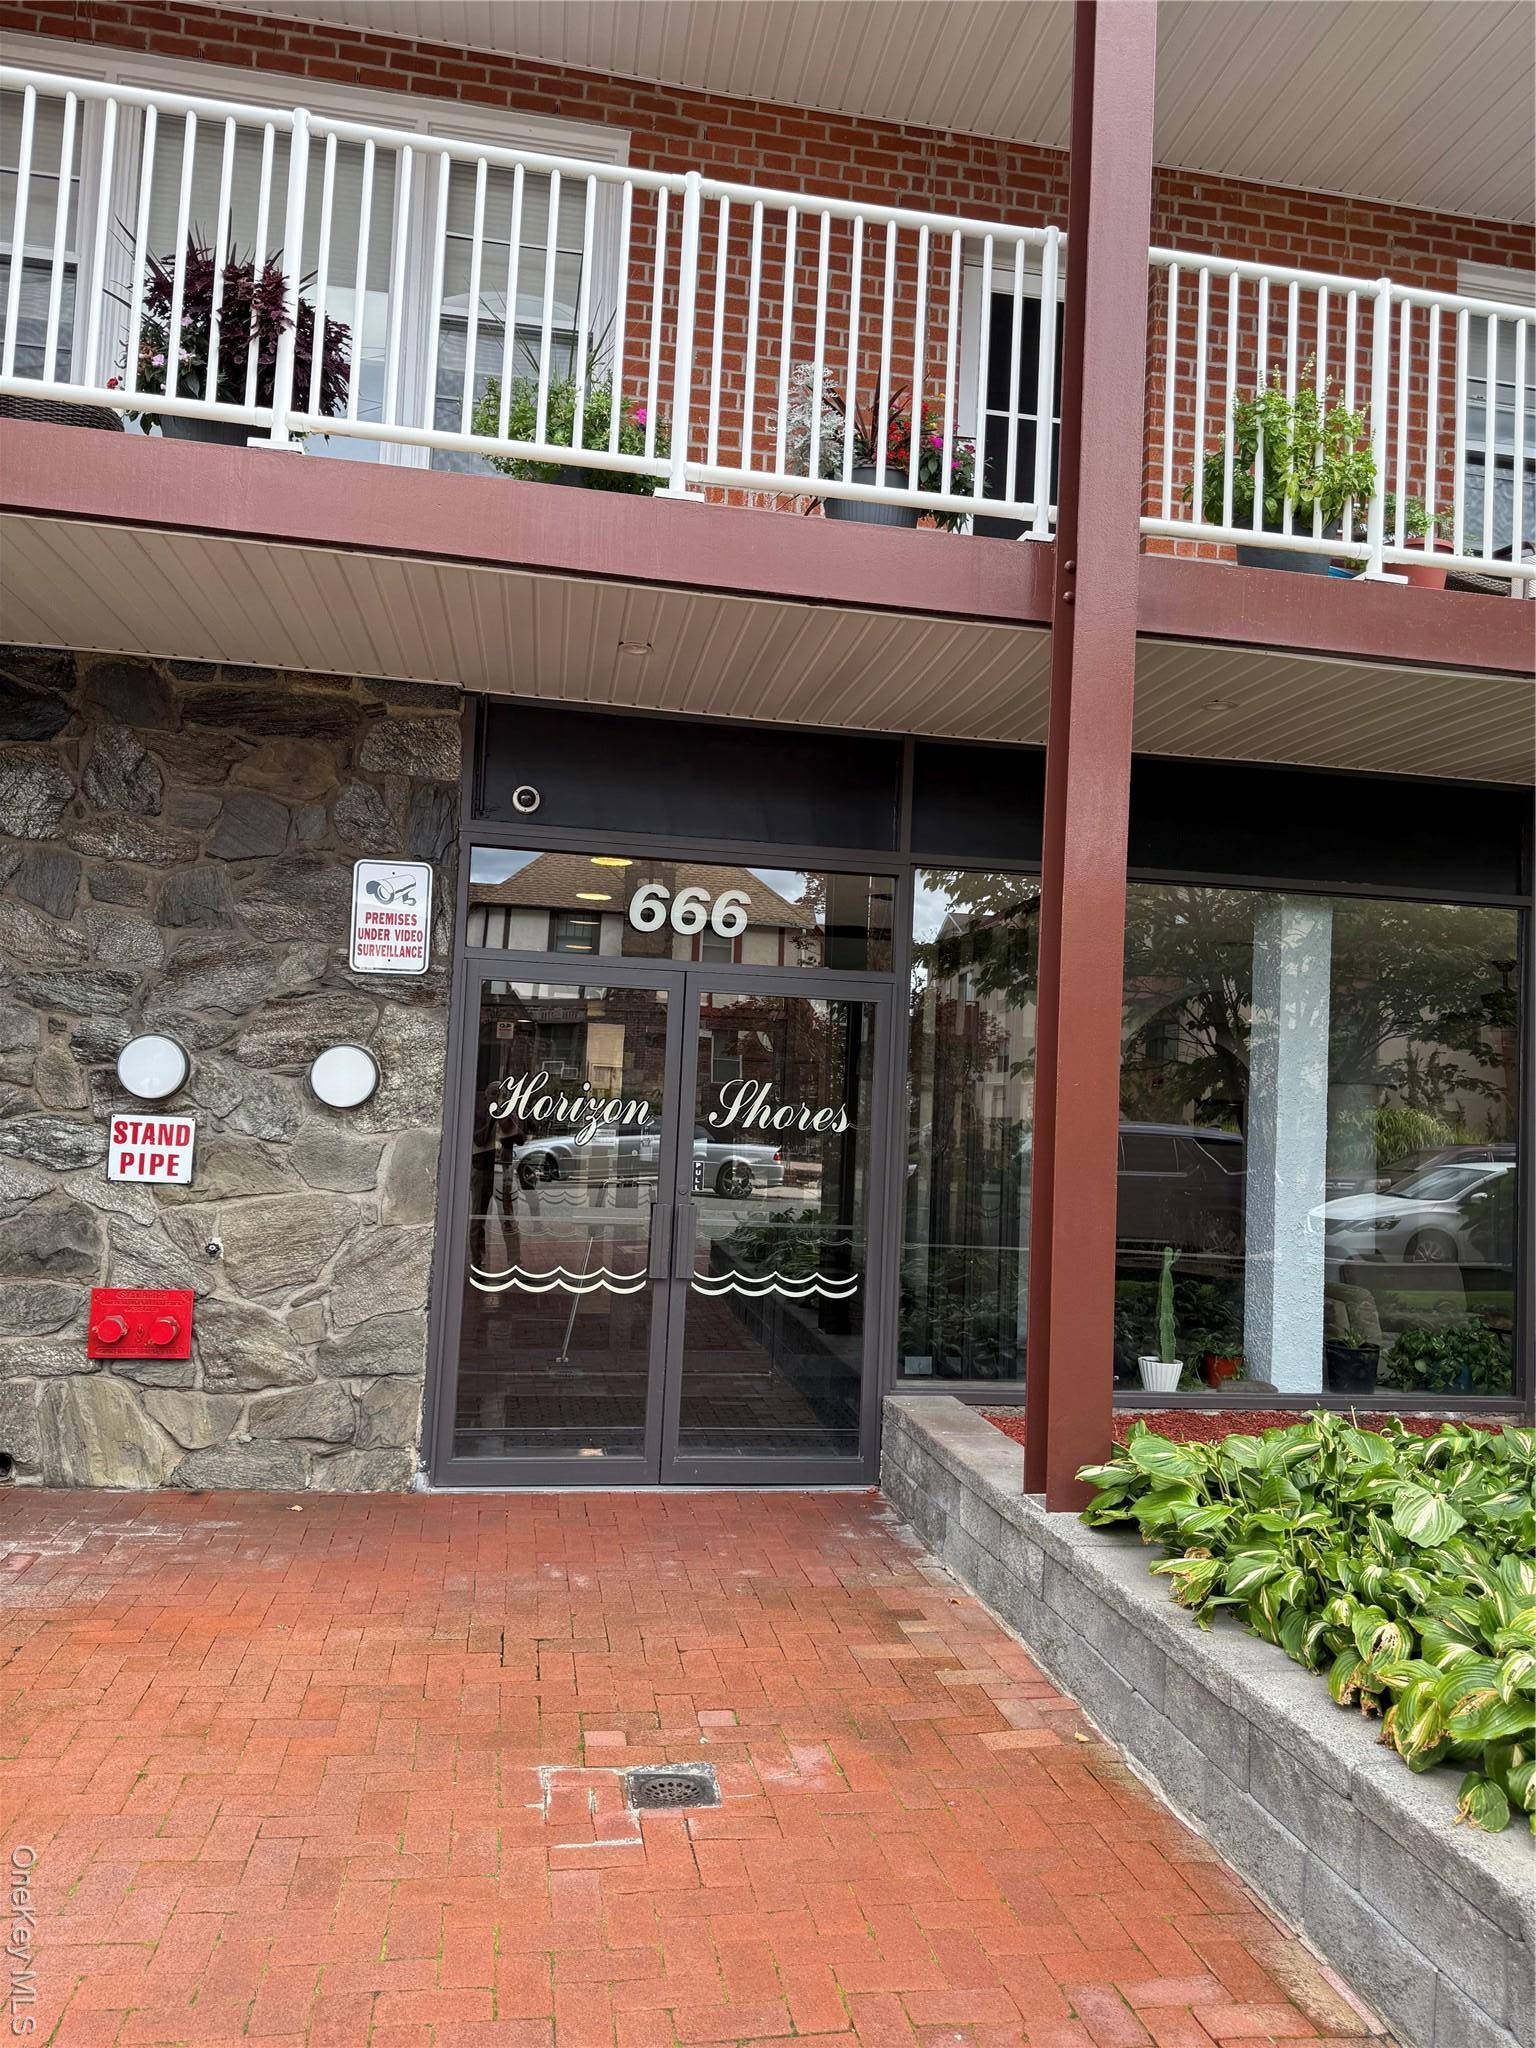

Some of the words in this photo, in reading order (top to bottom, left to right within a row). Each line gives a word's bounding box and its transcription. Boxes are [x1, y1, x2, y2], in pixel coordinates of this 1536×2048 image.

[365, 911, 418, 927] PREMISES
[629, 883, 752, 938] 666
[357, 927, 391, 941] UNDER
[394, 929, 424, 943] VIDEO
[357, 943, 423, 959] SURVEILLANCE
[488, 1070, 654, 1147] Horizon
[708, 1079, 851, 1133] Shores
[113, 1120, 191, 1147] STAND
[119, 1151, 180, 1177] PIPE
[694, 1161, 702, 1191] PULL
